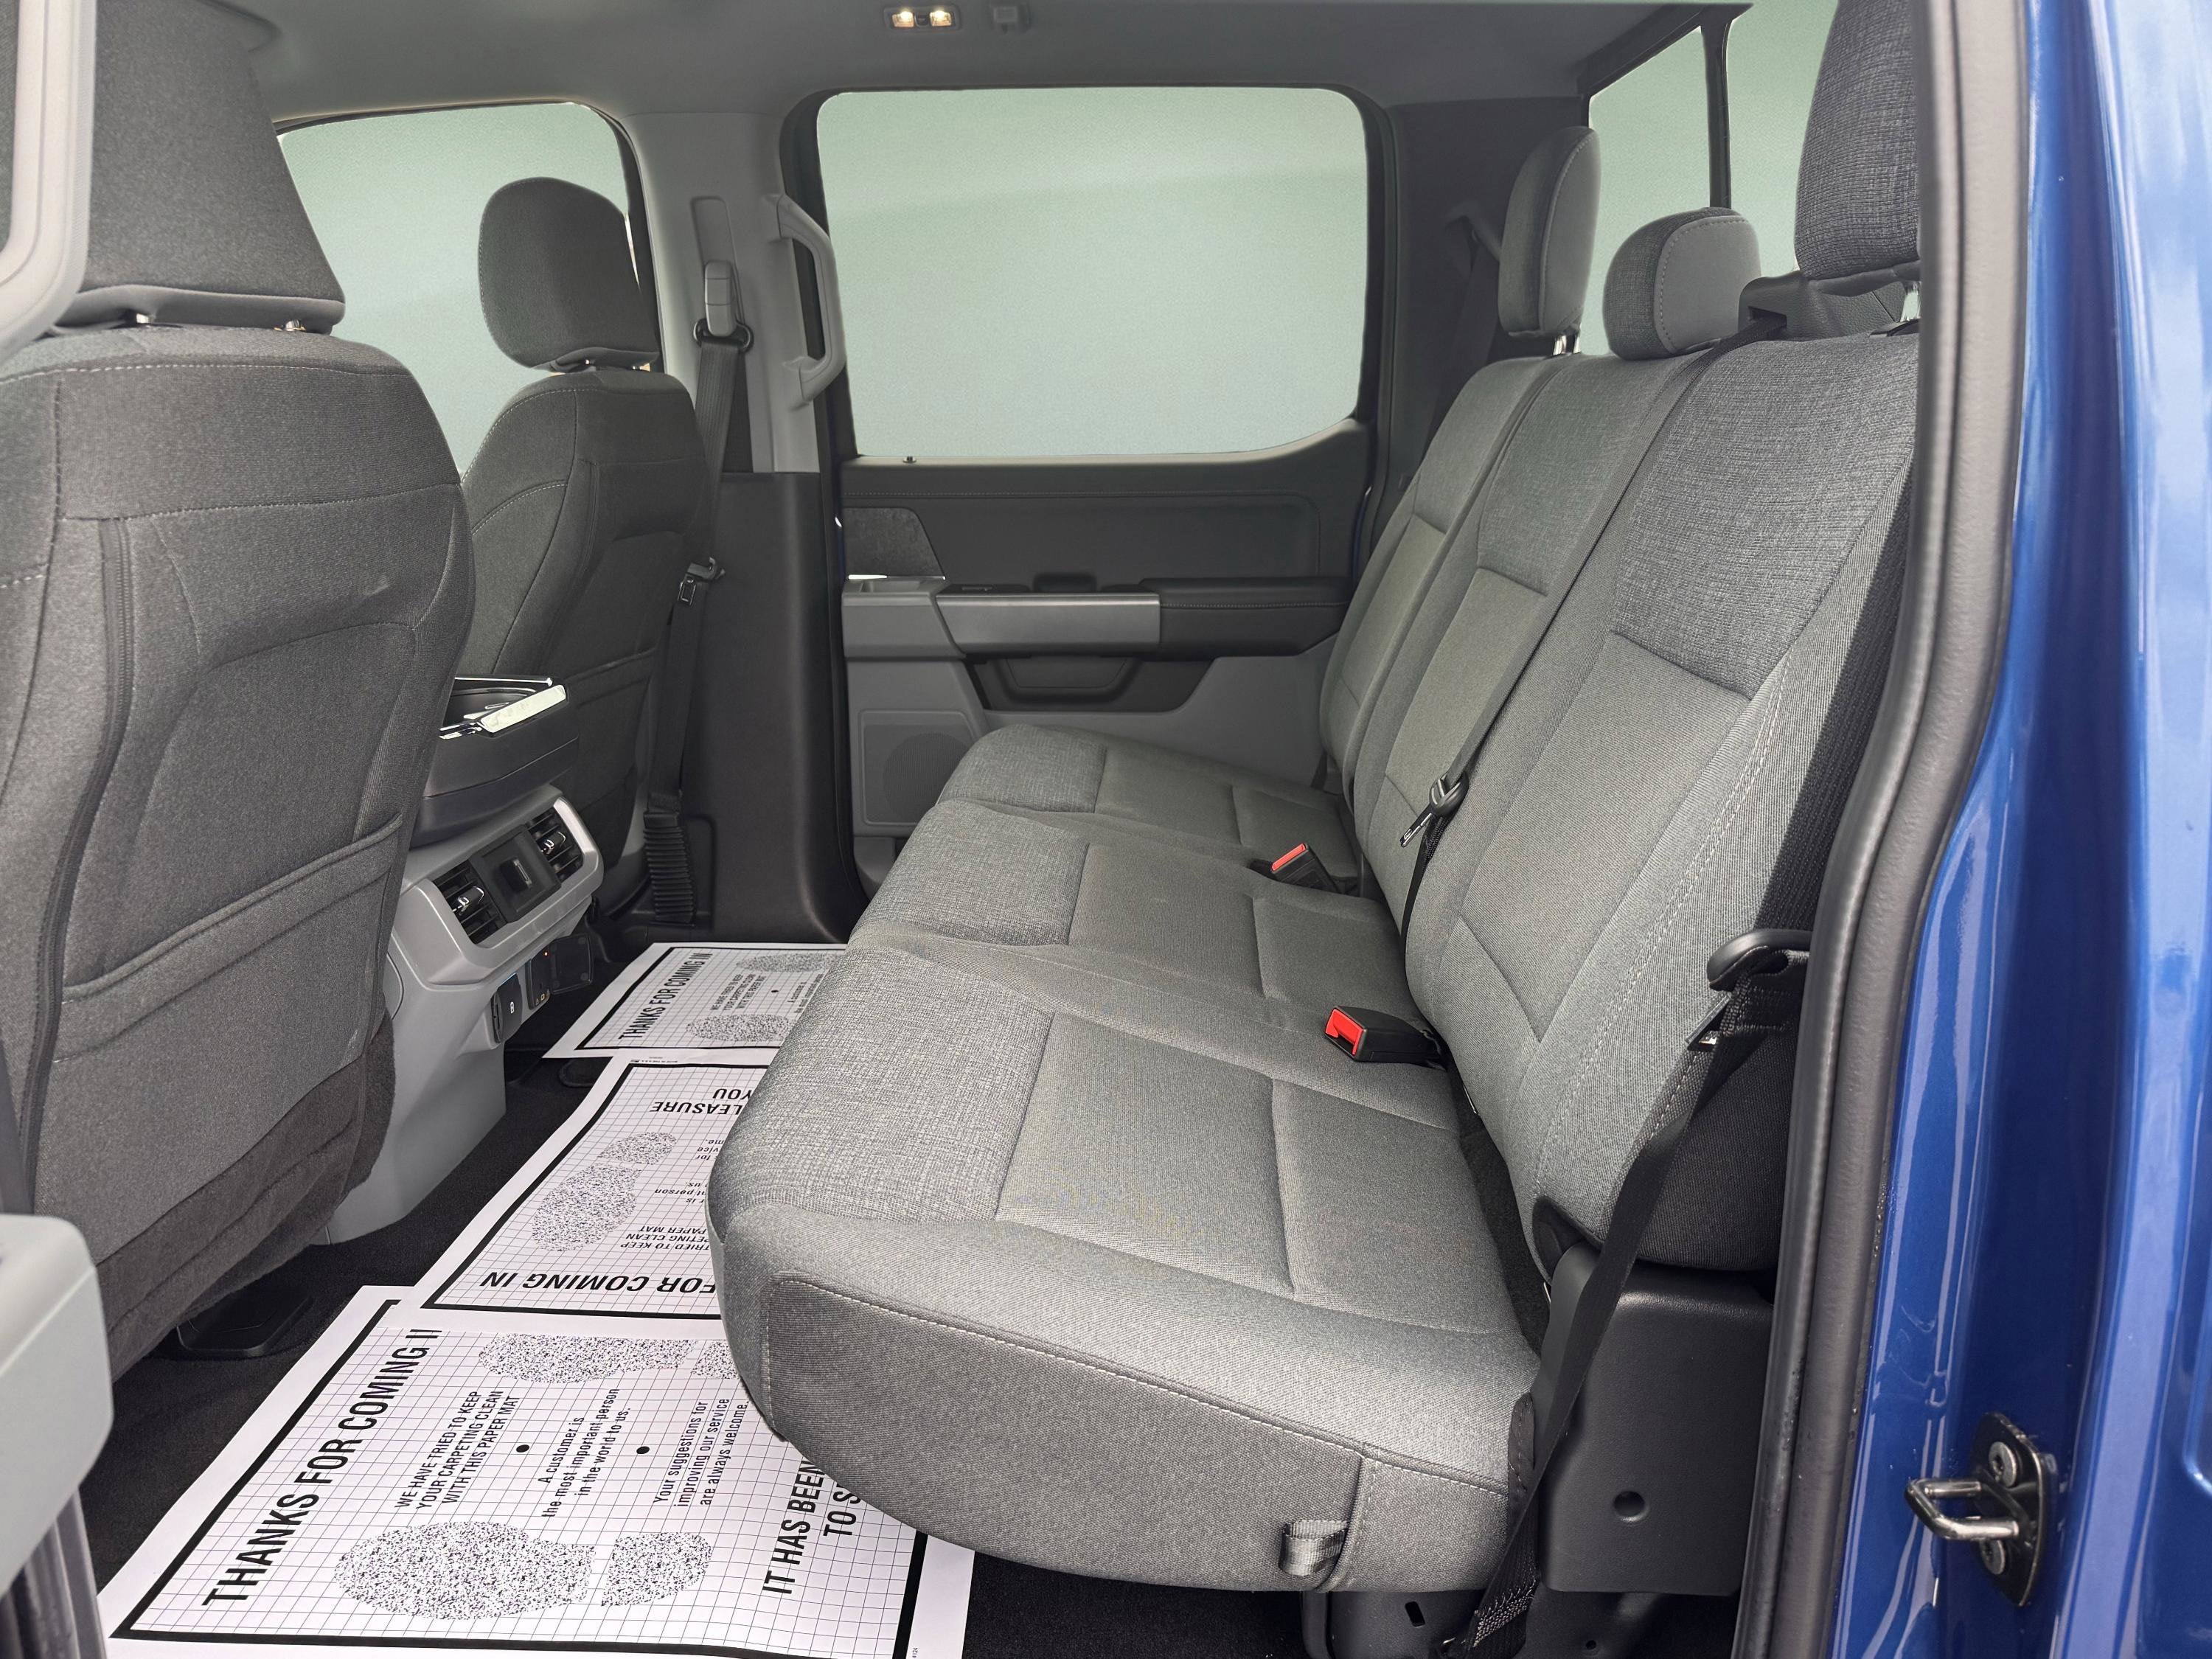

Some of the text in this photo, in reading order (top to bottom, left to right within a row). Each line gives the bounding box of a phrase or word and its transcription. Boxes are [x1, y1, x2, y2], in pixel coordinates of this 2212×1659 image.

[649, 989, 681, 1004] FOR
[664, 961, 706, 987] COMING
[619, 1007, 666, 1040] THANKS
[650, 1102, 743, 1115] LEASURE
[712, 1088, 752, 1100] YOU
[479, 1271, 716, 1293] FOR COMING IN
[621, 1241, 651, 1249] KEEP
[201, 1493, 320, 1606] THANKS
[293, 1439, 364, 1484] FOR
[338, 1347, 431, 1430] COMING
[394, 1391, 481, 1508] WE HAVE TRIED TO KEEP
[416, 1391, 504, 1509] YOUR CARPETING CLEAN
[442, 1396, 521, 1503] WITH THIS PAPER MAT
[541, 1388, 620, 1517] the most important person
[546, 1428, 579, 1472] customer
[568, 1417, 585, 1426] is
[574, 1408, 630, 1495] in the world to us.
[653, 1402, 708, 1503] Your suggestions for
[674, 1399, 730, 1506] improving our service
[700, 1401, 749, 1505] are always welcome.
[762, 1460, 826, 1594] IT HAS BEEN
[823, 1511, 857, 1537] TO
